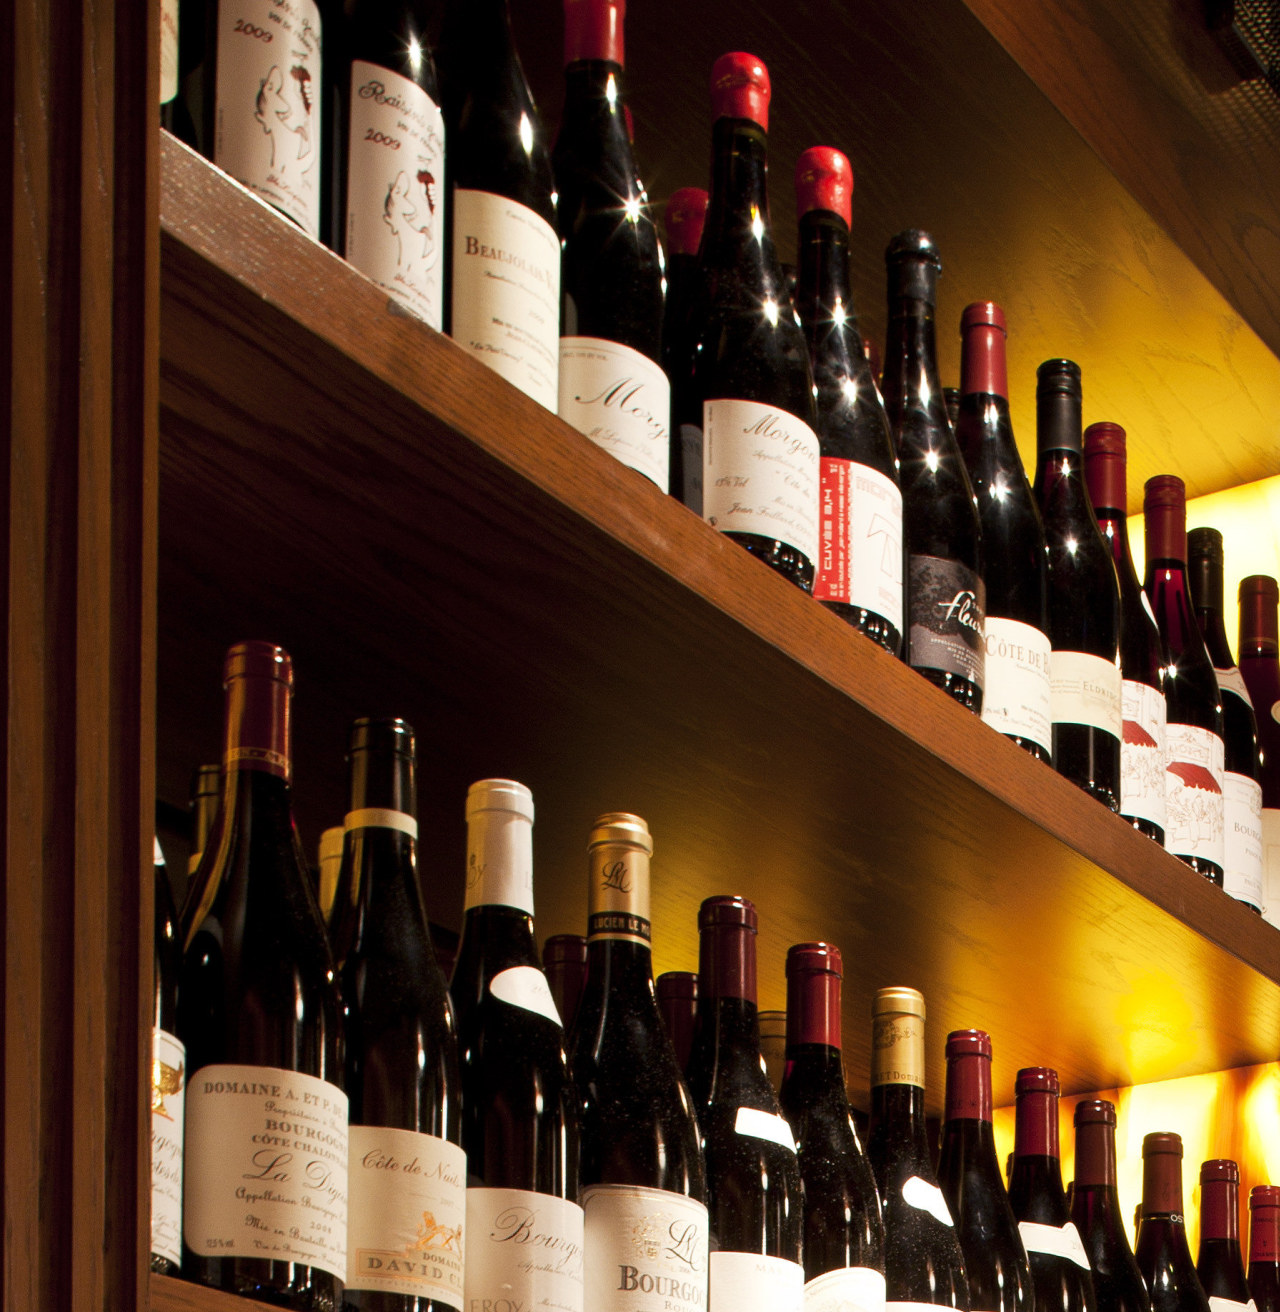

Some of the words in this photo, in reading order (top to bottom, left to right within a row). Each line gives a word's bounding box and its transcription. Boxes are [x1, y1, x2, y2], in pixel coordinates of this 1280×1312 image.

[743, 413, 817, 465] Morgon
[985, 633, 1024, 663] CÔTE
[203, 1082, 281, 1097] DOMAINE
[251, 1133, 290, 1149] CÔTE
[242, 1149, 293, 1182] La
[361, 1149, 400, 1170] Côte
[403, 1157, 421, 1175] de
[367, 1256, 443, 1280] DAVID
